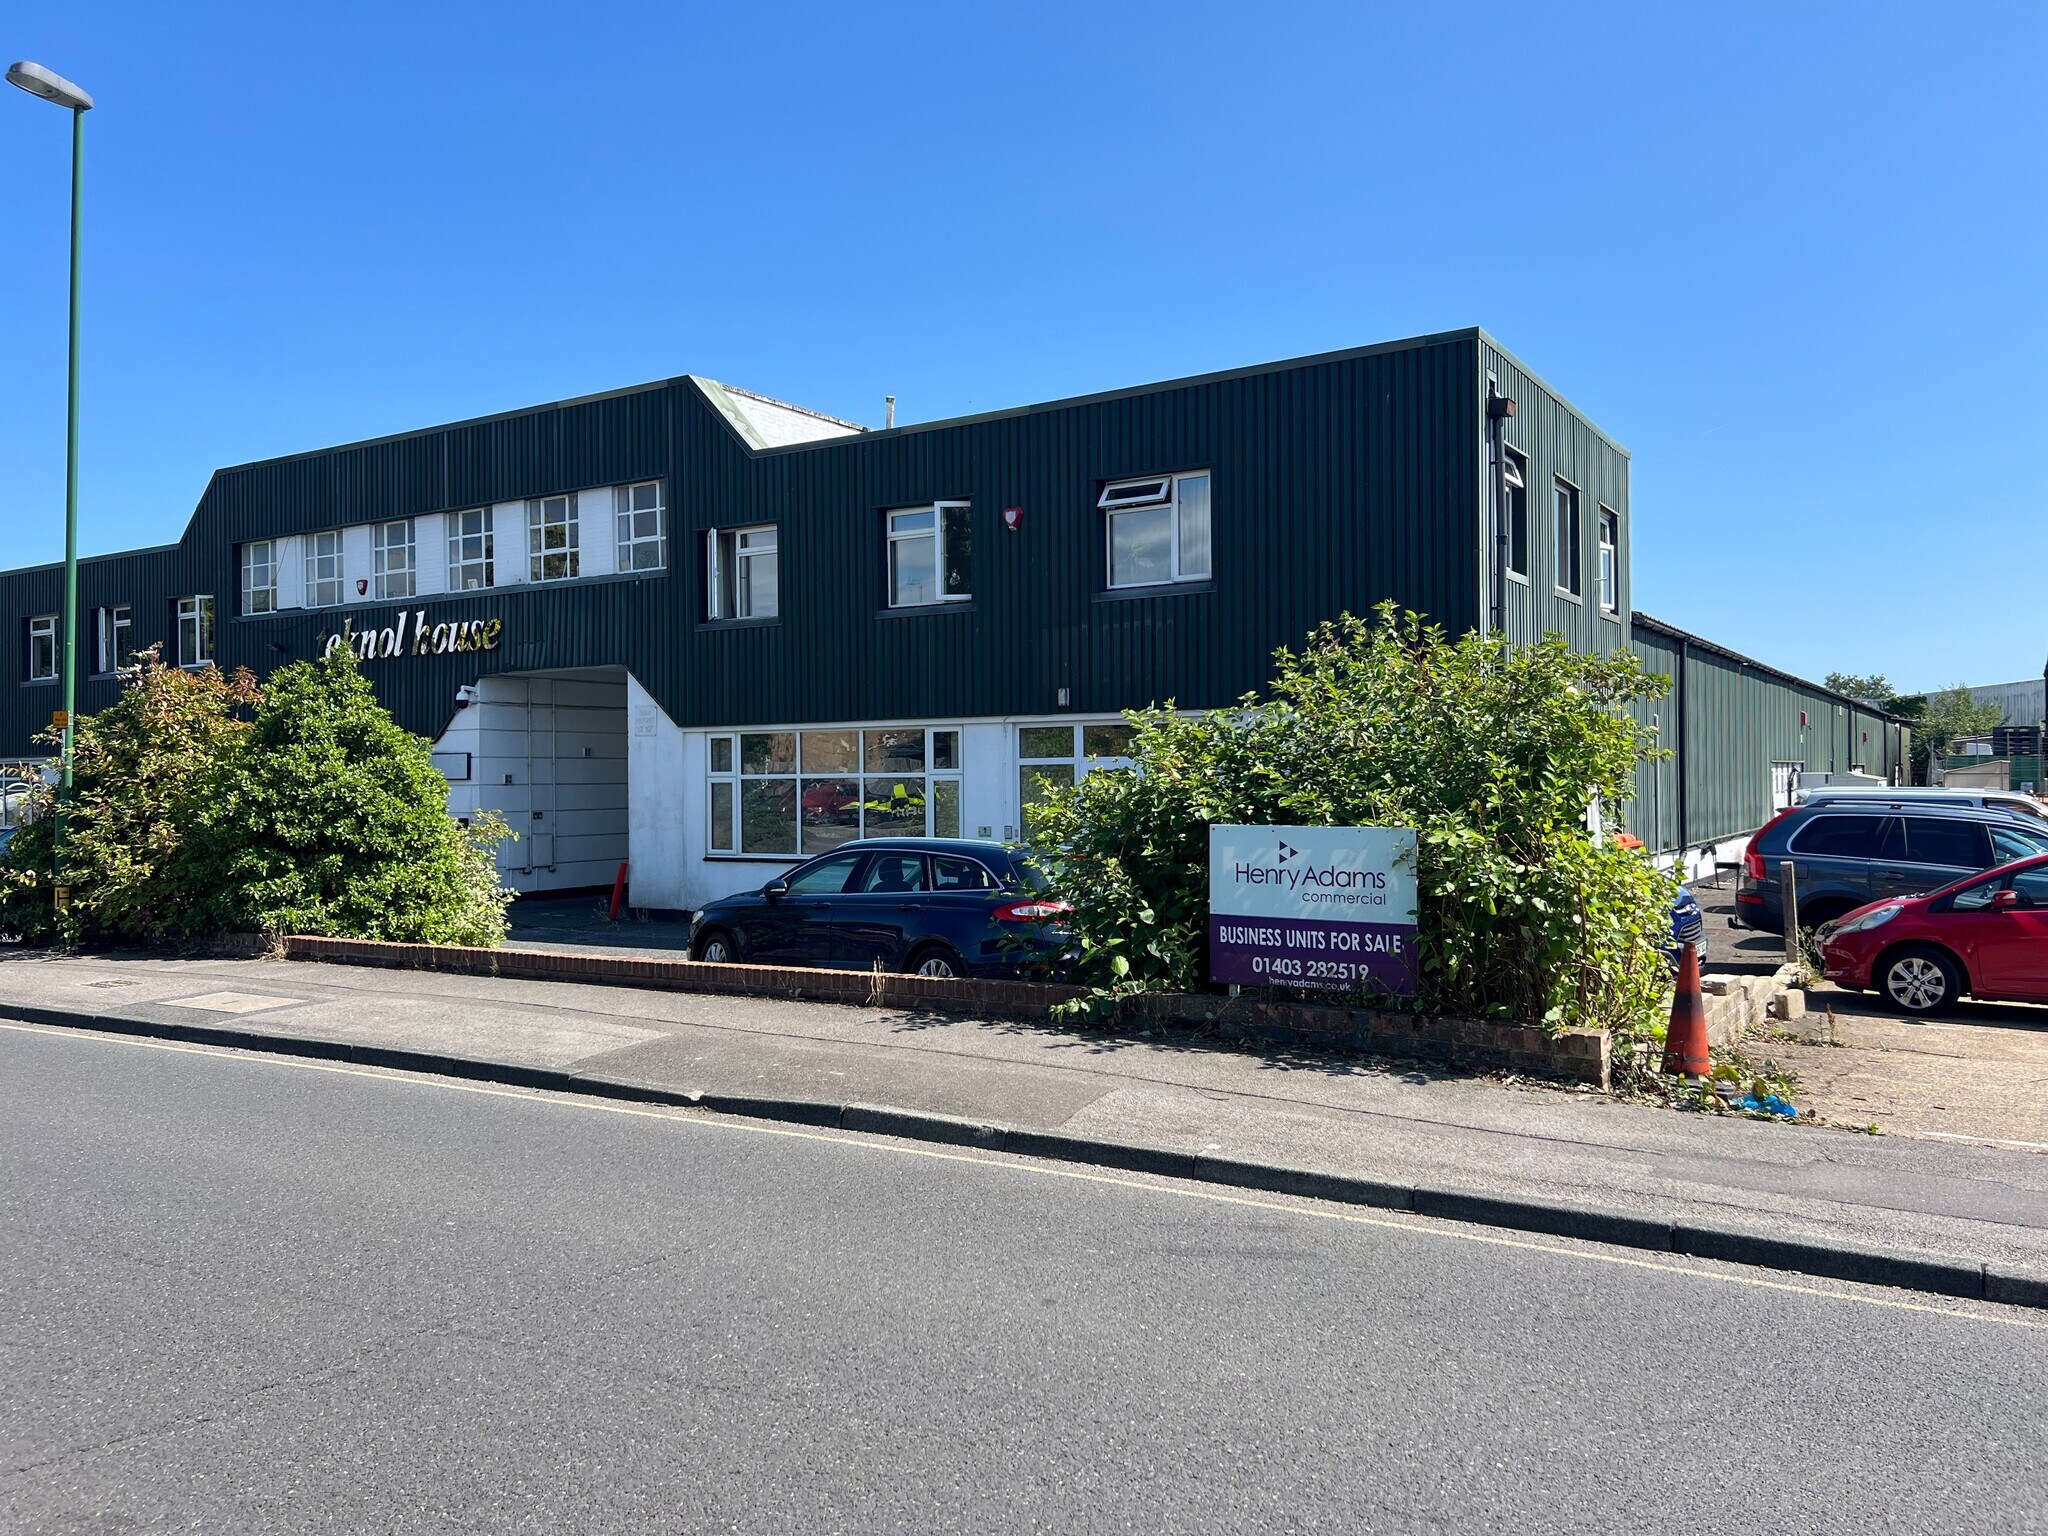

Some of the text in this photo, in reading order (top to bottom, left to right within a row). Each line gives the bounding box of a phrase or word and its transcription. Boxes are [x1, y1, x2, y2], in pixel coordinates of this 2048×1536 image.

[412, 610, 502, 656] house
[1235, 862, 1386, 891] Henry Adams
[1301, 892, 1386, 906] commercial
[1219, 925, 1402, 954] BUSINESS UNITS FOR SALE
[1252, 956, 1369, 981] 01403 282519
